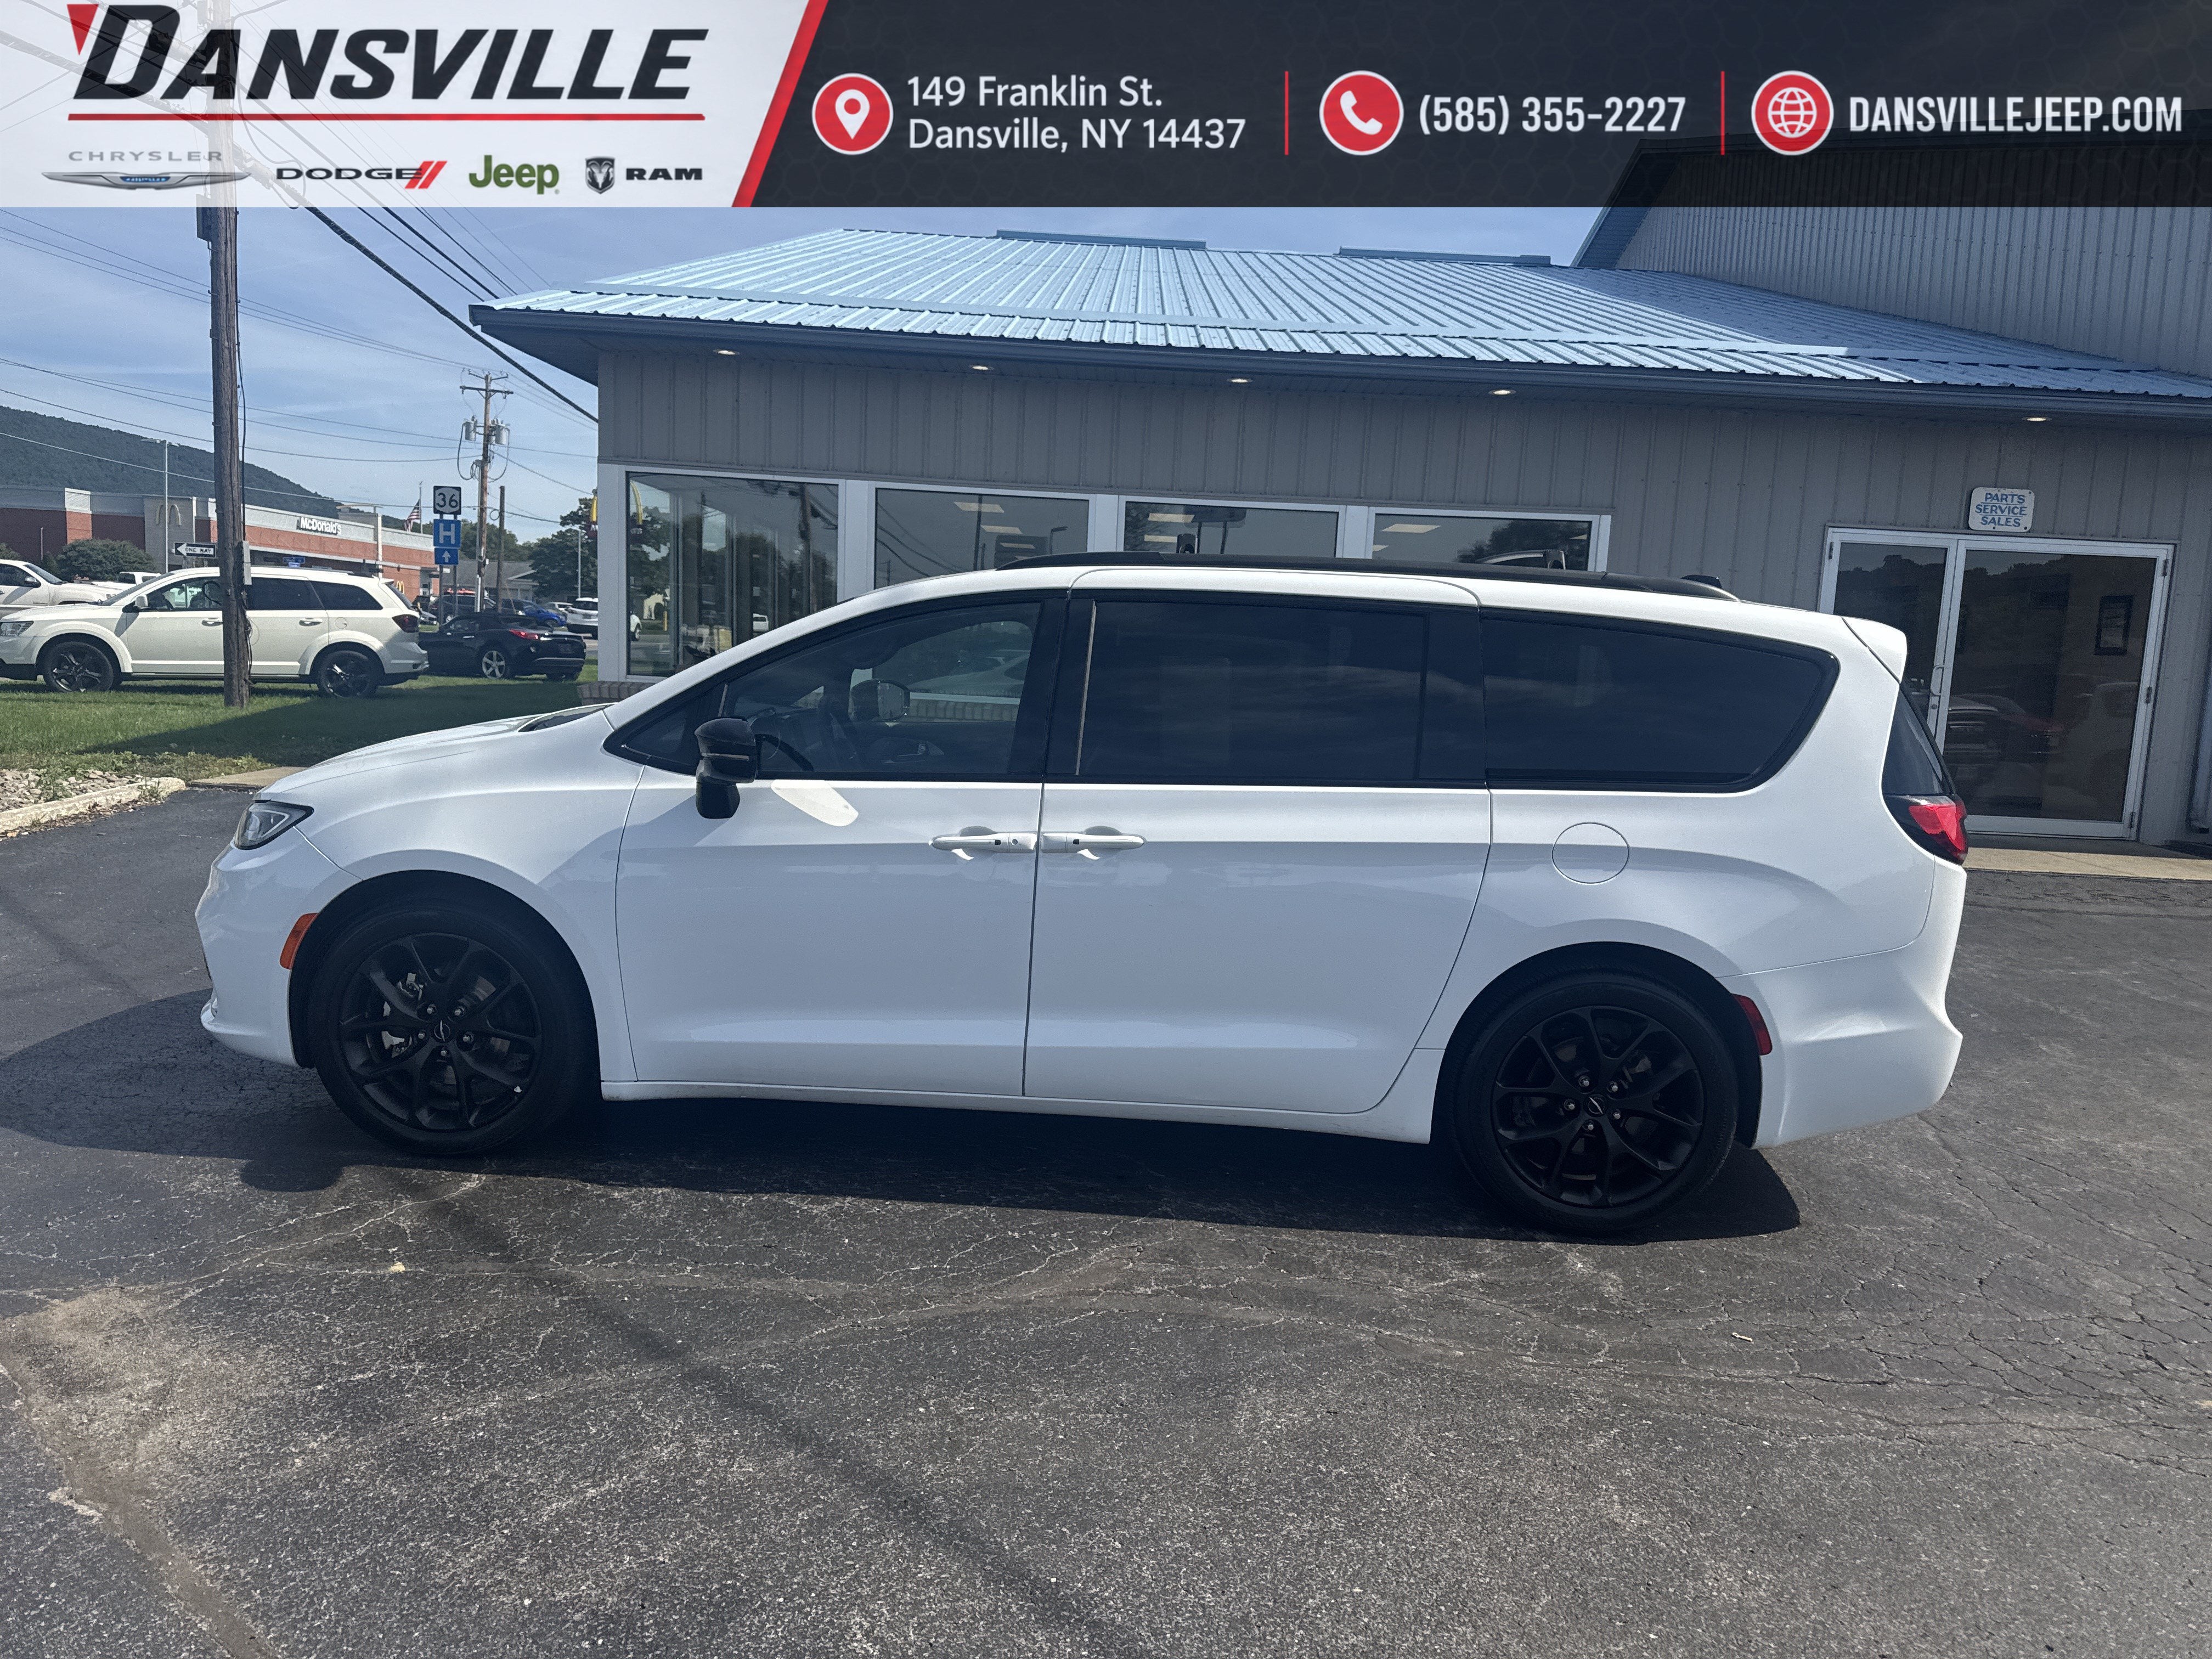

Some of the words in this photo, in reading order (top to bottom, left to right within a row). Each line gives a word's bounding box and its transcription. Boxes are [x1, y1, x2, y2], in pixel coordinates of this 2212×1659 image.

[436, 493, 458, 508] 36
[1985, 493, 2025, 504] PARTS
[1975, 504, 2027, 515] SERVICE
[301, 517, 341, 534] McDonald's
[1980, 516, 2021, 527] SALES
[439, 523, 455, 544] H
